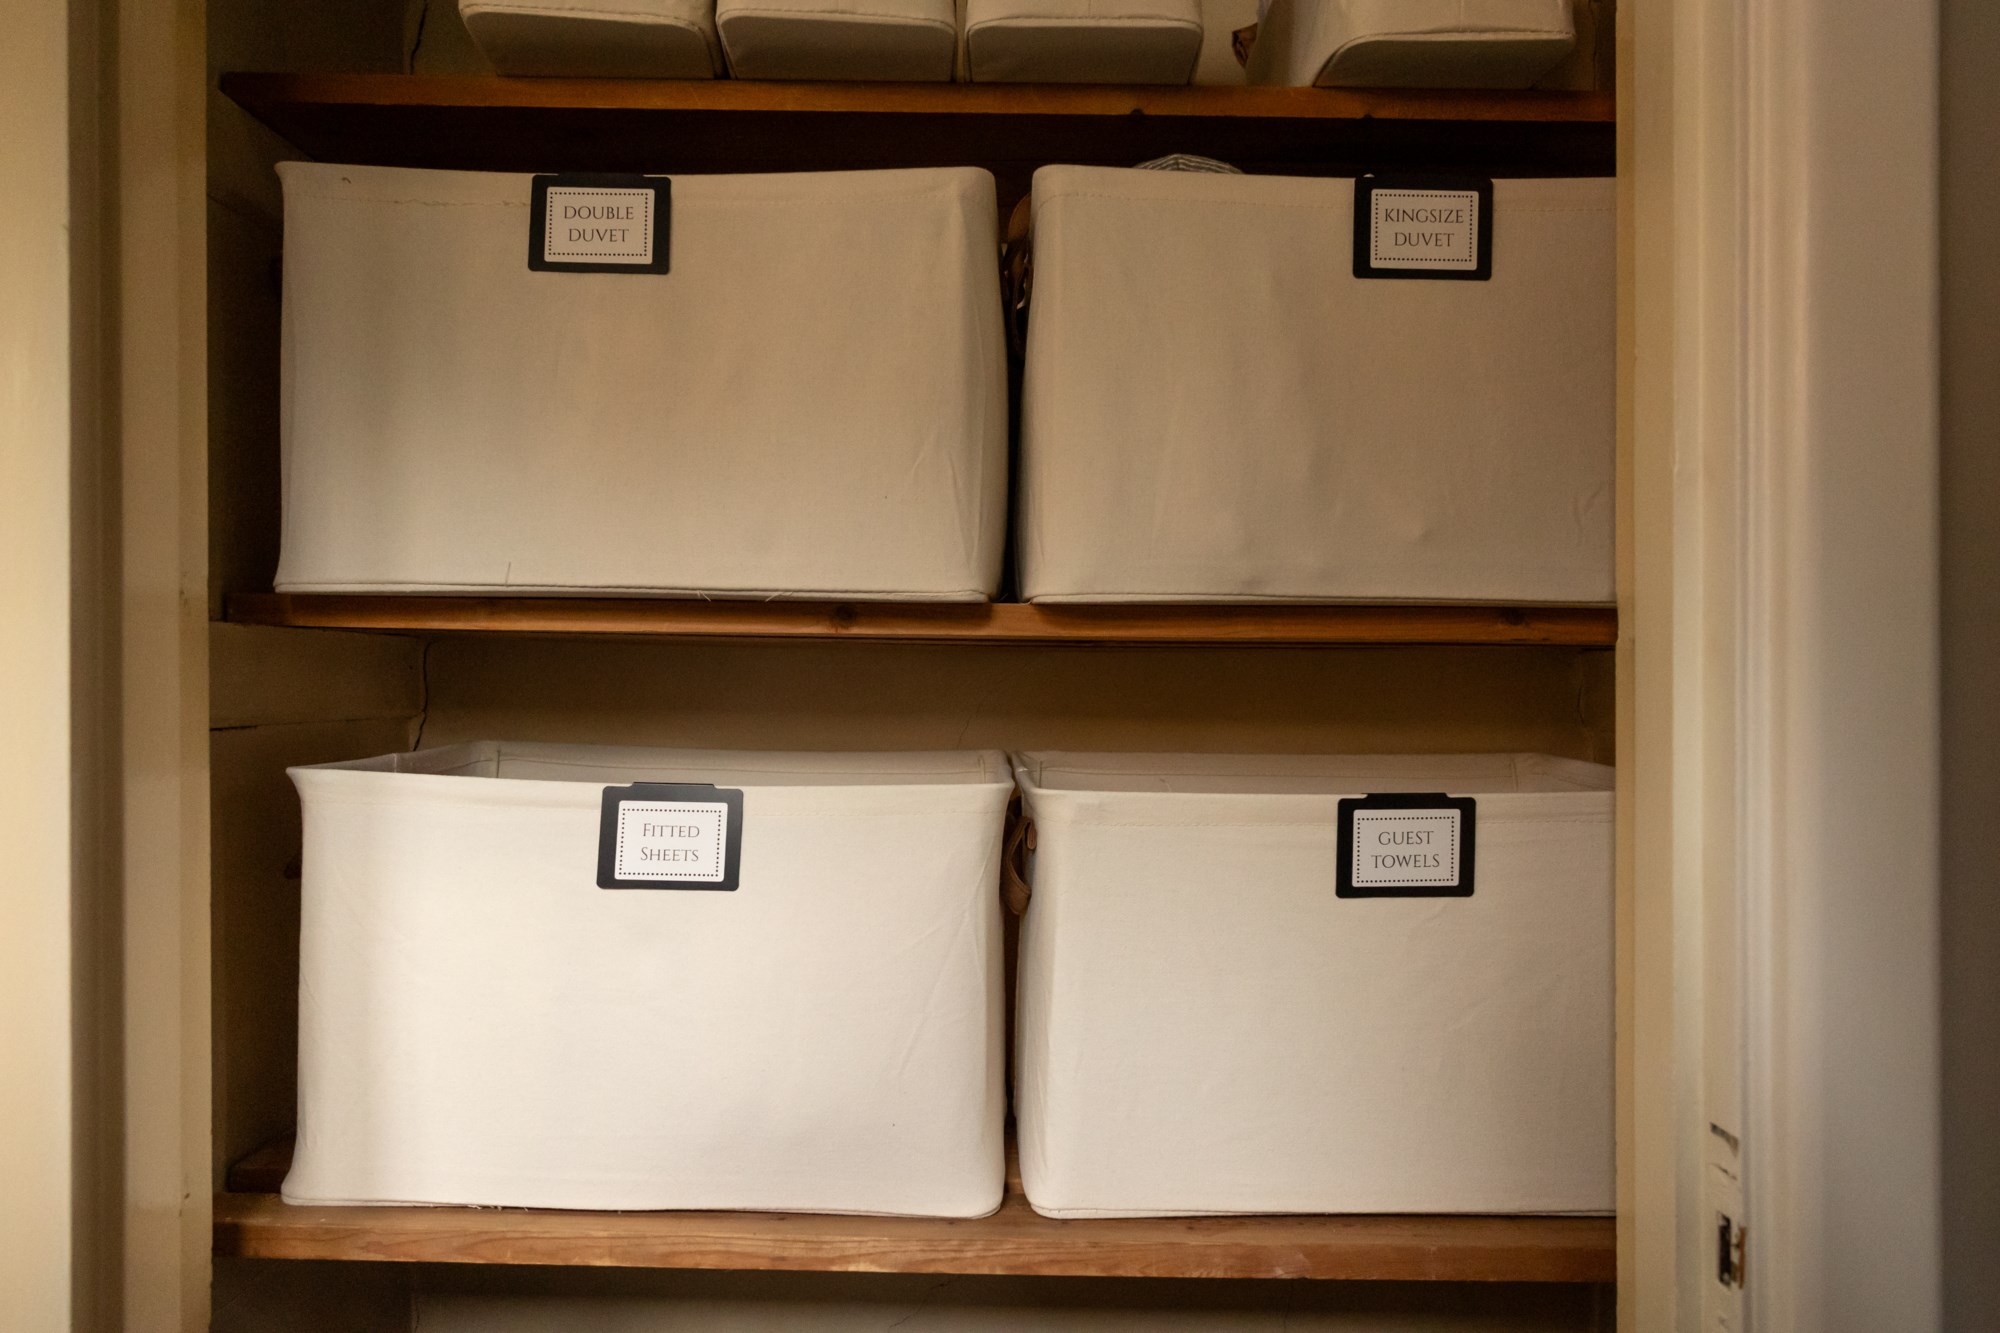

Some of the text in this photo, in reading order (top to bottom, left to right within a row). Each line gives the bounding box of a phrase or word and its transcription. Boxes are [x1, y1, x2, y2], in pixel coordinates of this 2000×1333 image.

[563, 205, 634, 220] DOUBLE
[1384, 208, 1465, 224] KINGSIZE
[568, 228, 630, 243] DUVET
[1394, 232, 1455, 248] DUVET
[1378, 830, 1434, 846] GUEST
[1371, 853, 1440, 869] TOWELS
